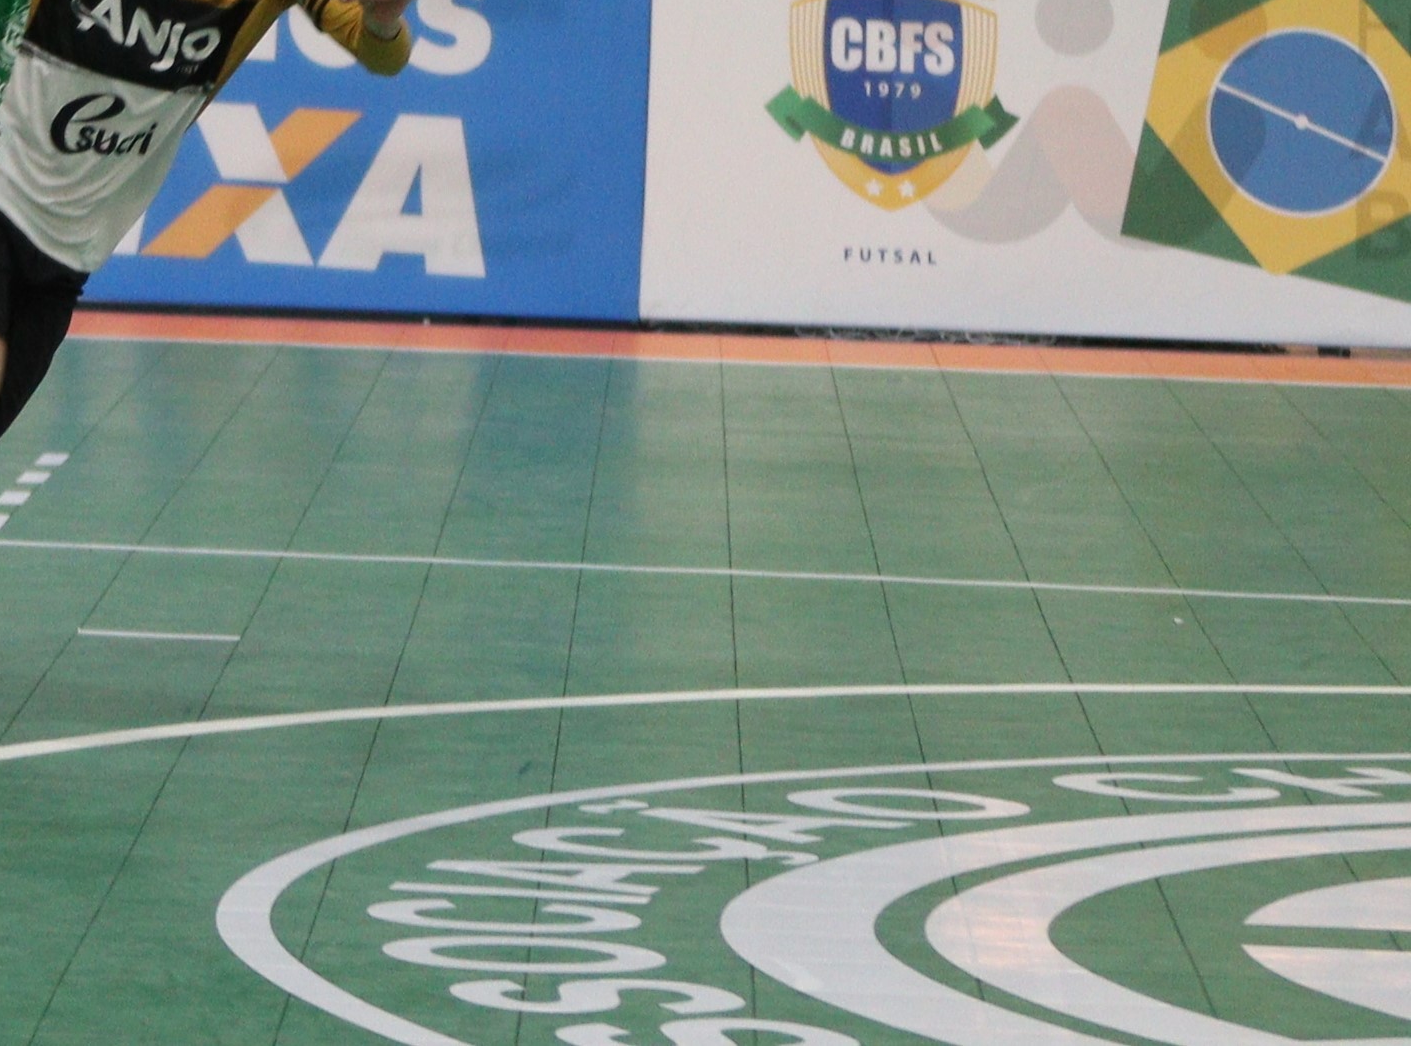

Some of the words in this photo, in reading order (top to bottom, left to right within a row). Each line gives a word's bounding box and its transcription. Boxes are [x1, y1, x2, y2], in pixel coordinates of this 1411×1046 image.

[831, 17, 955, 77] CBFS
[864, 81, 922, 99] 1979
[840, 127, 943, 159] BRASIL
[843, 247, 937, 266] FUTSAL
